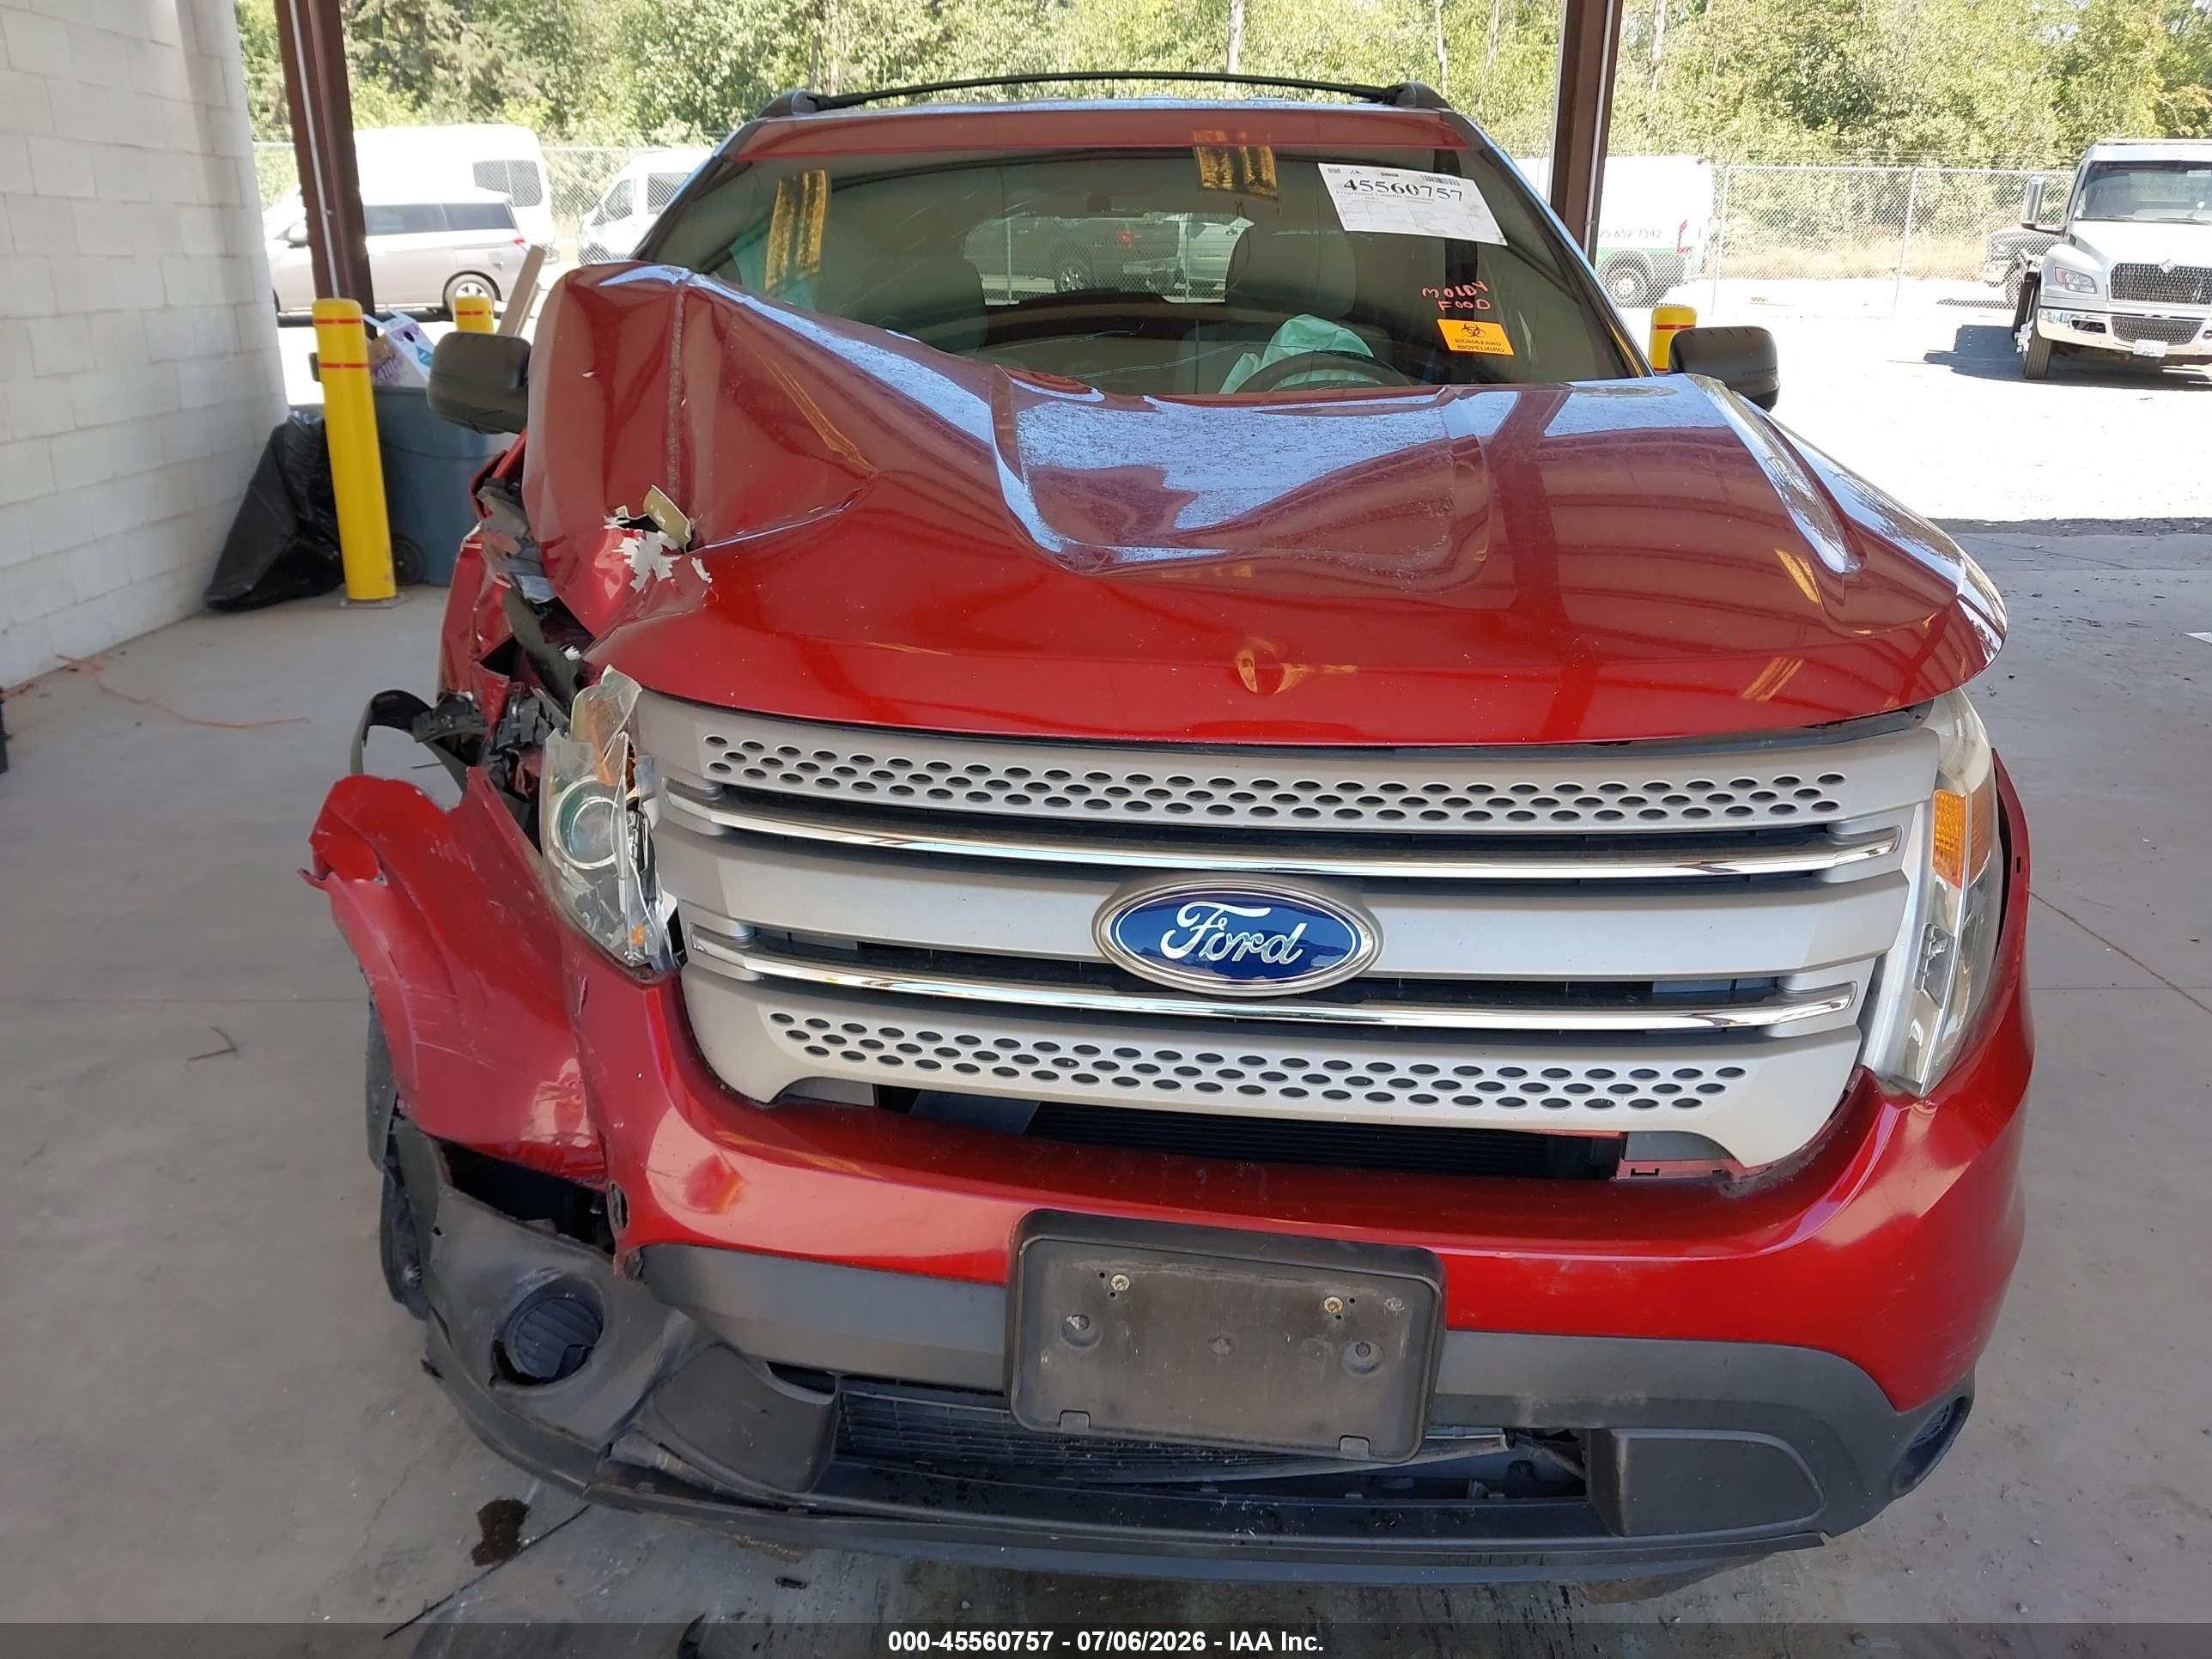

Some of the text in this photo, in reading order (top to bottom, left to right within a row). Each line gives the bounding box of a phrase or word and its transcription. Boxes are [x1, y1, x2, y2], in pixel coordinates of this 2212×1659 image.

[1343, 179, 1463, 202] 45560757
[1437, 299, 1491, 311] FOOD
[1455, 338, 1502, 347] BIOHAZARD
[1160, 902, 1308, 965] Ford
